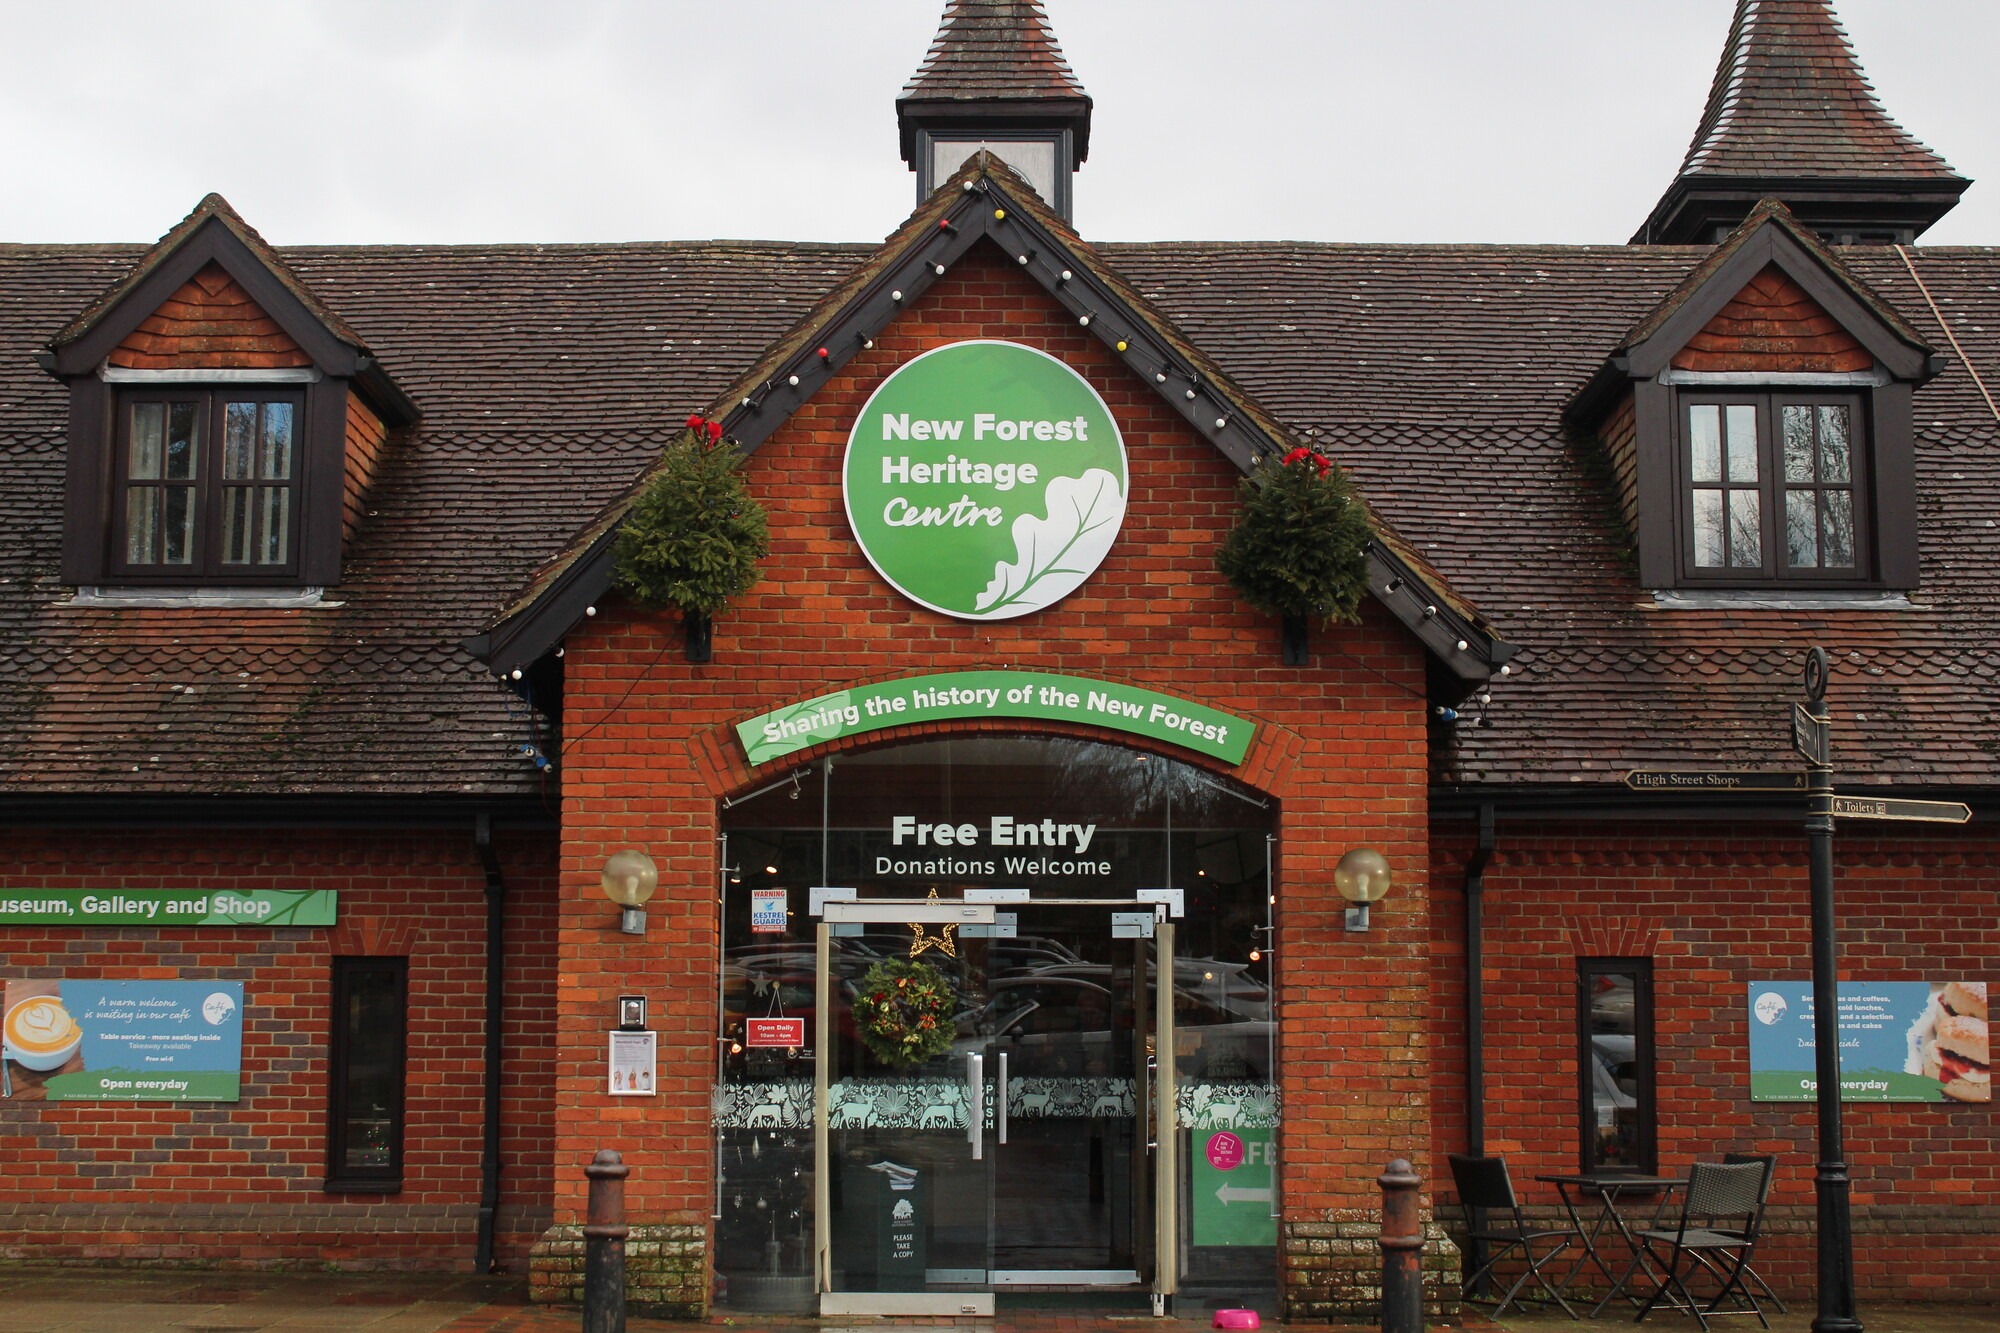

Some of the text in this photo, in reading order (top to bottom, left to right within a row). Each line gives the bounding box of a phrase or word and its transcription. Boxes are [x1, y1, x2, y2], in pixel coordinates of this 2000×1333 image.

[882, 413, 1088, 441] New Forest
[882, 454, 1038, 491] Heritage
[883, 494, 1003, 527] Centre
[763, 685, 1228, 745] Sharing the history of the New Forest
[1636, 774, 1740, 788] High Street Shops
[1844, 801, 1874, 814] Toilets
[892, 816, 1097, 854] Free Entry
[875, 856, 1112, 875] Donations Welcome
[81, 895, 159, 918] Gallery
[165, 896, 207, 914] and
[213, 896, 272, 918] Shop
[98, 996, 178, 1007] A warm welcome
[1863, 995, 1891, 1003] coffees,
[204, 1002, 226, 1014] Café
[1756, 1001, 1777, 1013] Café
[1854, 1004, 1884, 1012] lunches,
[84, 1008, 191, 1024] is waiting in our café
[171, 1034, 198, 1043] seating
[129, 1042, 192, 1050] Takeaway available
[100, 1078, 188, 1091] Open everyday
[985, 1084, 994, 1129] PUSH
